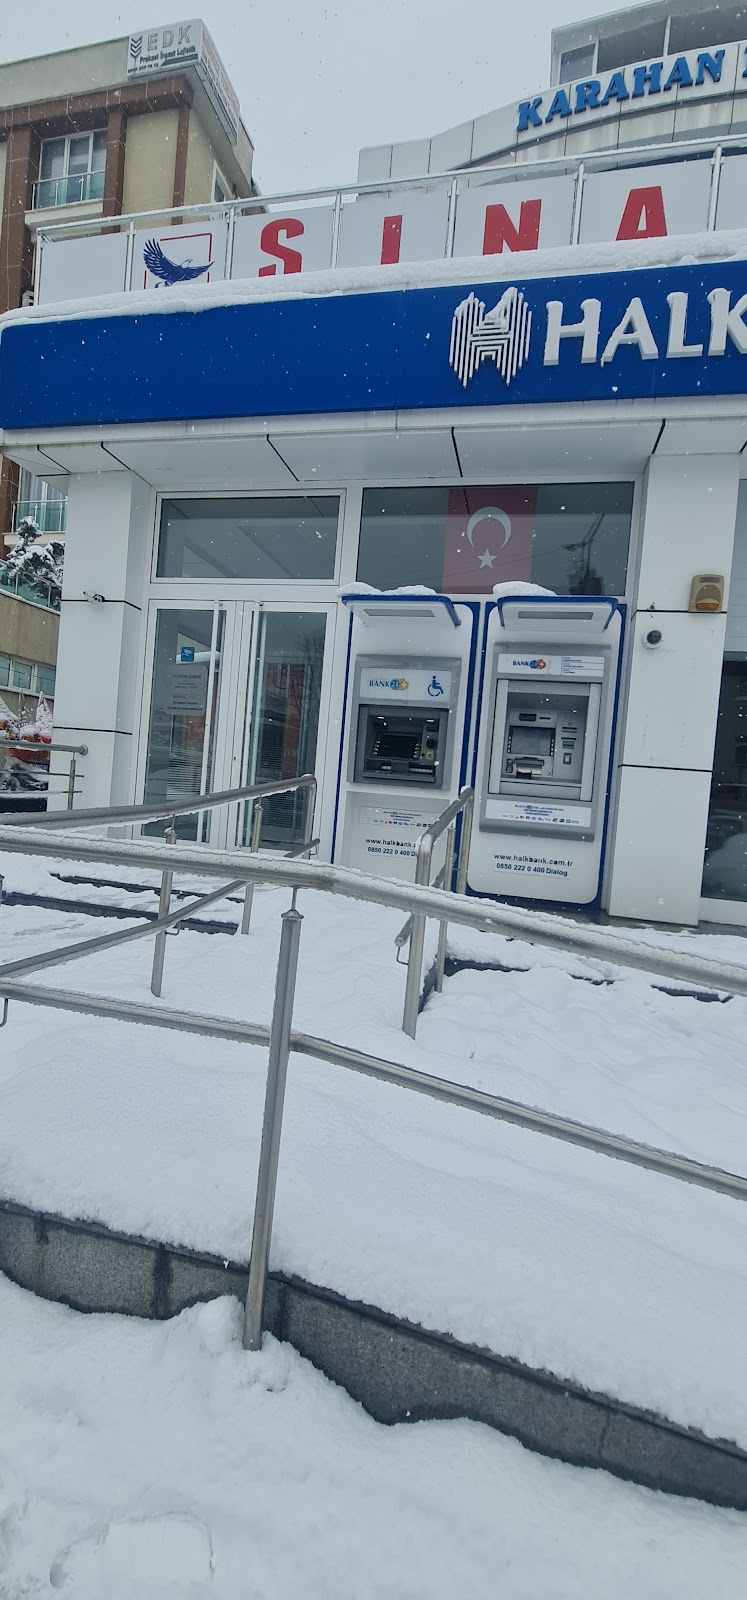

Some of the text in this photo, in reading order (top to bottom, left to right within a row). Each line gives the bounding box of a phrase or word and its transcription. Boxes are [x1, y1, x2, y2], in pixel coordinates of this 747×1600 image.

[147, 25, 192, 52] EDK
[517, 49, 726, 133] KARAHAN
[259, 185, 668, 277] SINA
[543, 287, 747, 366] HALK
[493, 853, 574, 867] www.halkbank.com.tr
[496, 862, 512, 870] 0850
[513, 864, 526, 872] 222
[533, 866, 545, 874] 400
[546, 867, 568, 878] Dialog
